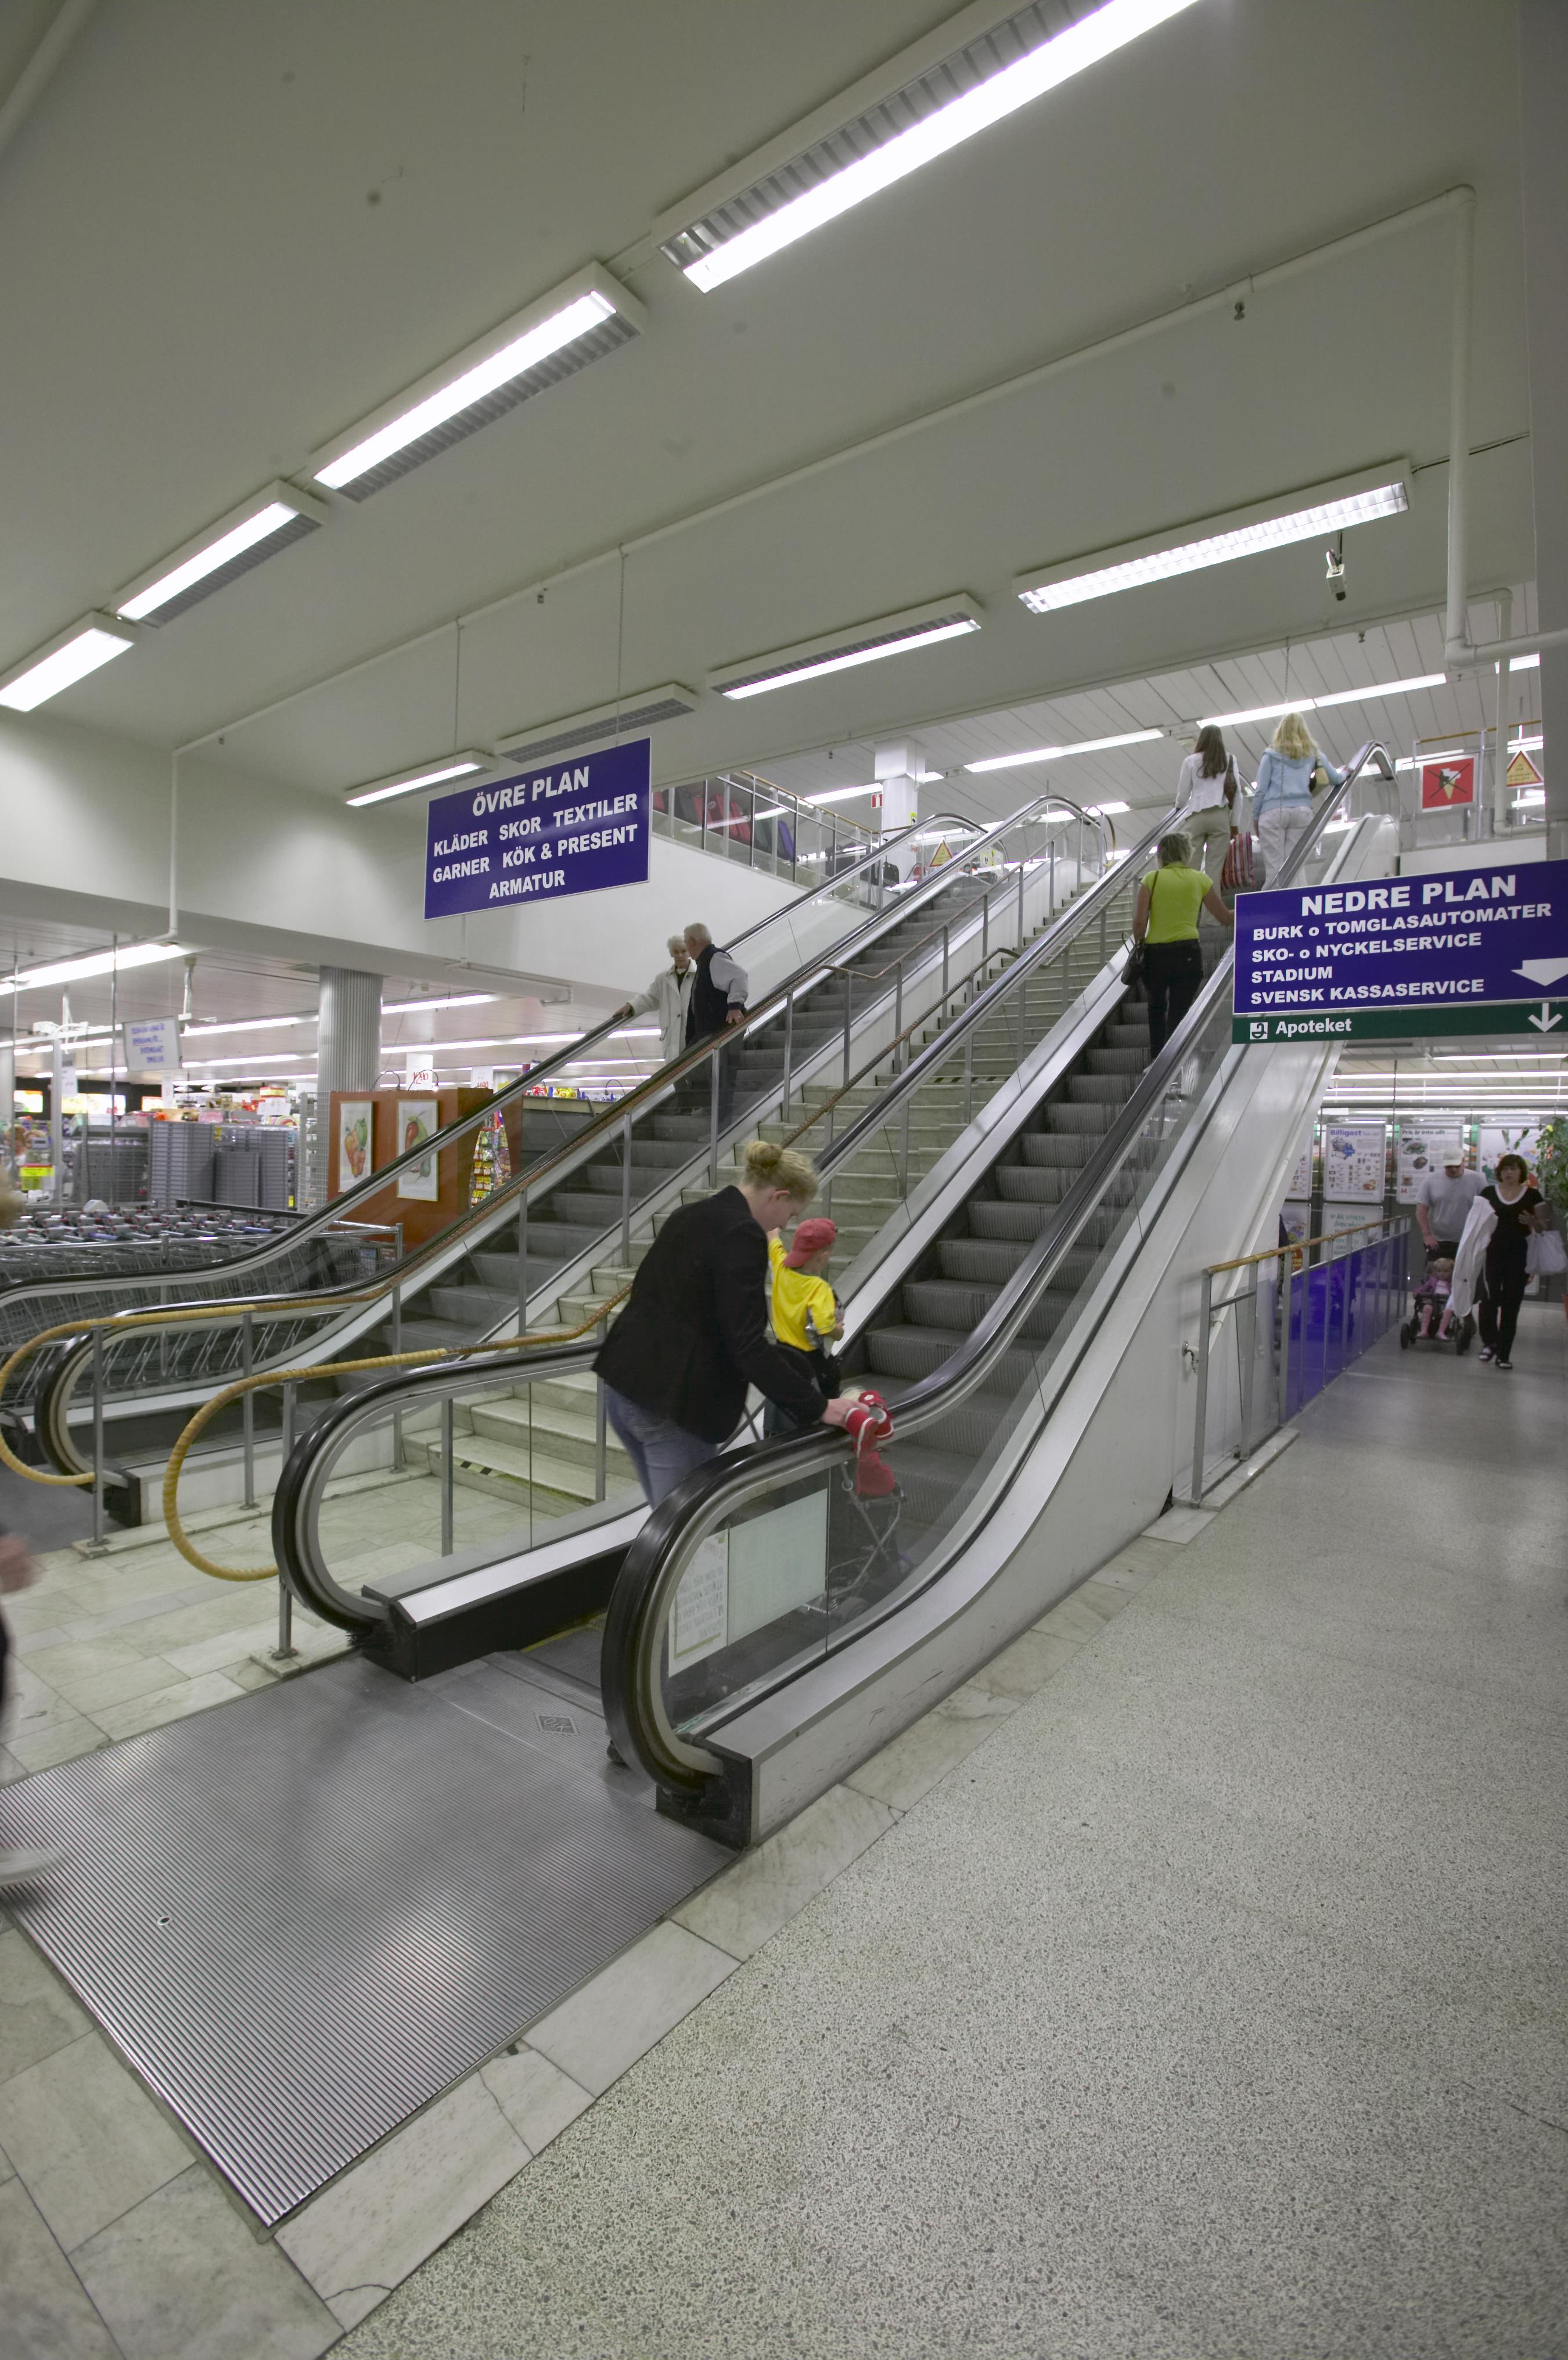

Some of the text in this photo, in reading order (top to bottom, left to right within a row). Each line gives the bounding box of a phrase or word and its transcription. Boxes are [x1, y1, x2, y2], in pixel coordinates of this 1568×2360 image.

[472, 766, 589, 816] ÖVRE PLAN
[434, 793, 637, 857] KLÄDER SKOR TEXTILER
[433, 824, 637, 883] GARNER KÖK & PRESENT
[489, 869, 565, 899] ARMATUR
[1301, 875, 1516, 916] NEDRE PLAN
[1253, 904, 1551, 941] BURK o TOMGLASAUTOMATER
[1252, 933, 1481, 962] SKO- o NYCKELSERVICE
[1251, 966, 1332, 983] STADIUM
[1251, 979, 1484, 1004] SVENSK KASSASERVICE
[1276, 1018, 1352, 1037] Apoteket
